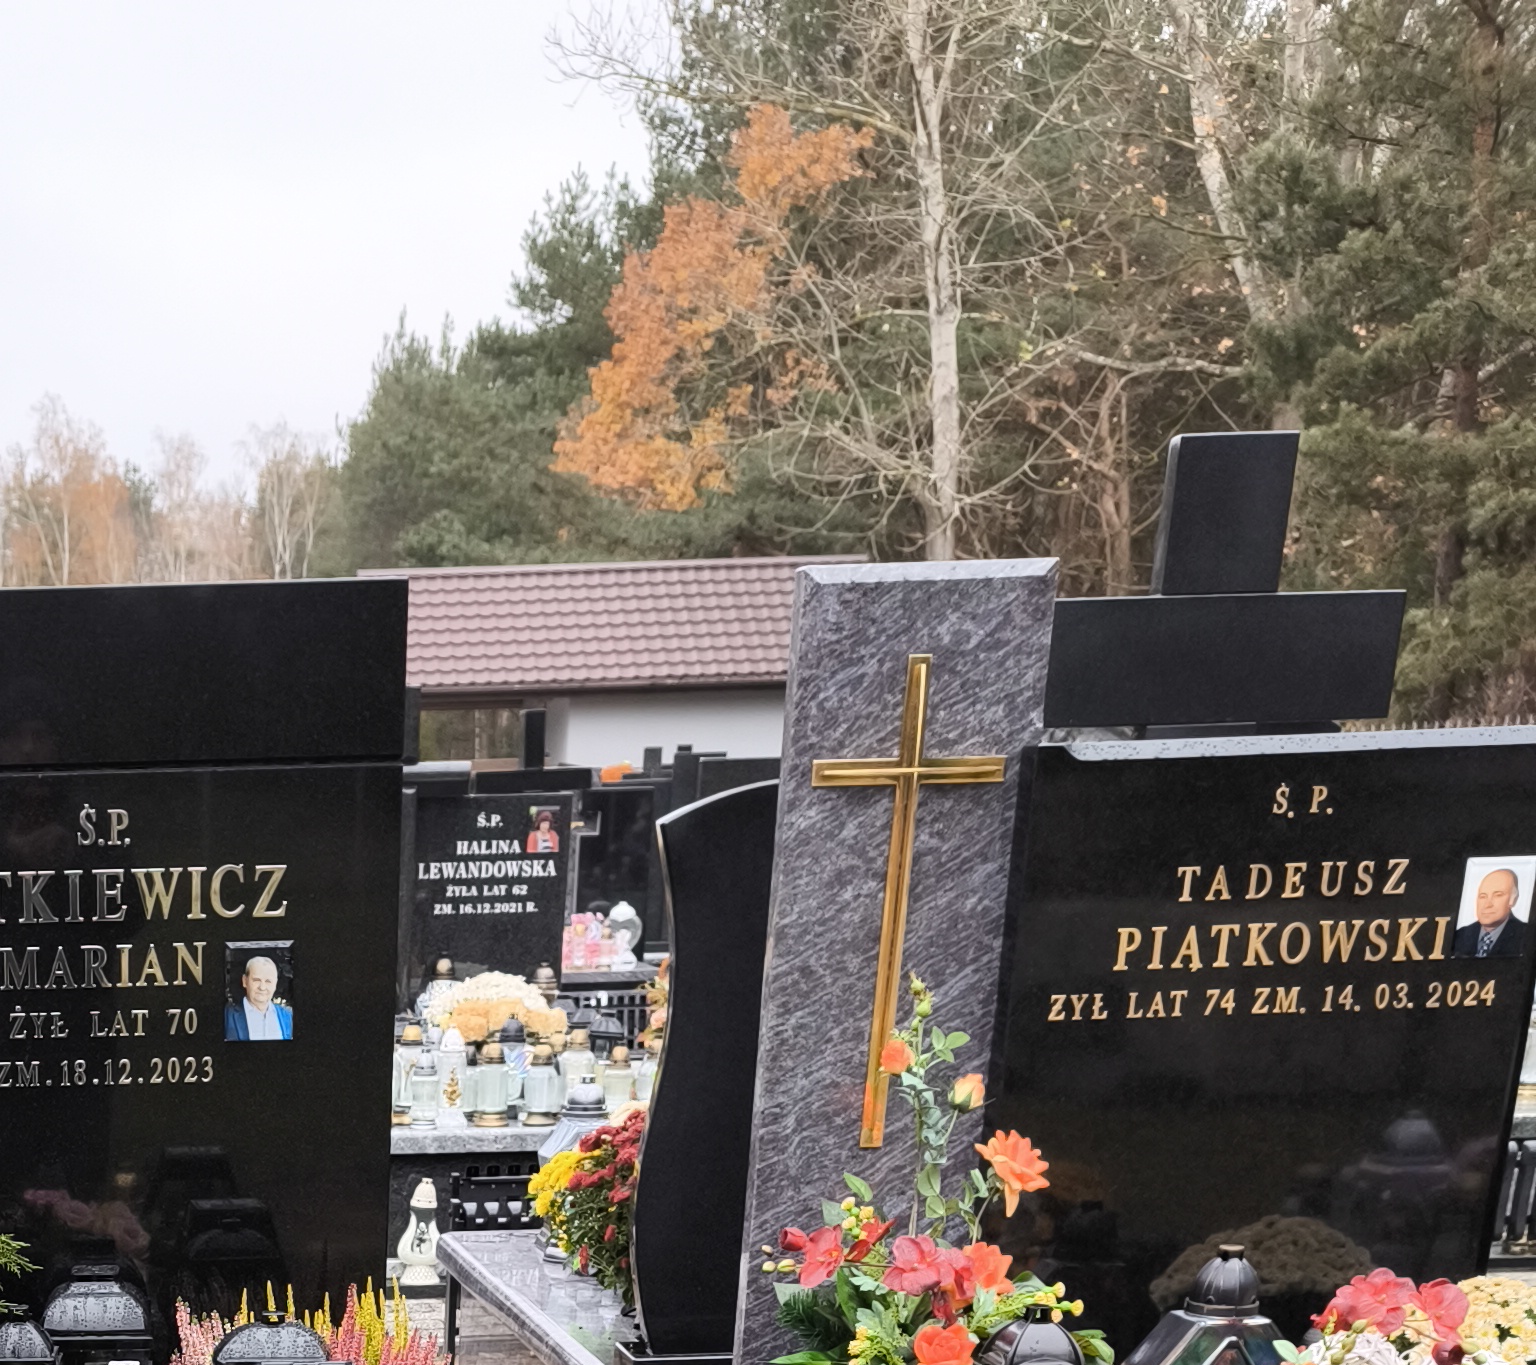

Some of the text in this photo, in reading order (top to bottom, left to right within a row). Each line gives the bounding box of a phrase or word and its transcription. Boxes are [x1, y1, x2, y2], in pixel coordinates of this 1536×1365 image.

[77, 803, 131, 847] Ś.P.
[476, 812, 504, 828] Ś.P.
[456, 840, 522, 855] HALINA
[418, 860, 558, 880] LEWANDOWSKA
[1178, 858, 1410, 902] TADEUSZ
[483, 884, 508, 896] LAT
[512, 884, 529, 896] 62
[1111, 916, 1452, 972] PIĄTKOWSKI
[0, 941, 207, 992] MARIAN
[1126, 990, 1189, 1020] LAT
[1203, 988, 1237, 1016] 74
[1251, 986, 1306, 1015] ZM.
[1425, 979, 1497, 1010] 2024
[9, 1005, 198, 1040] ŻYŁ LAT 70
